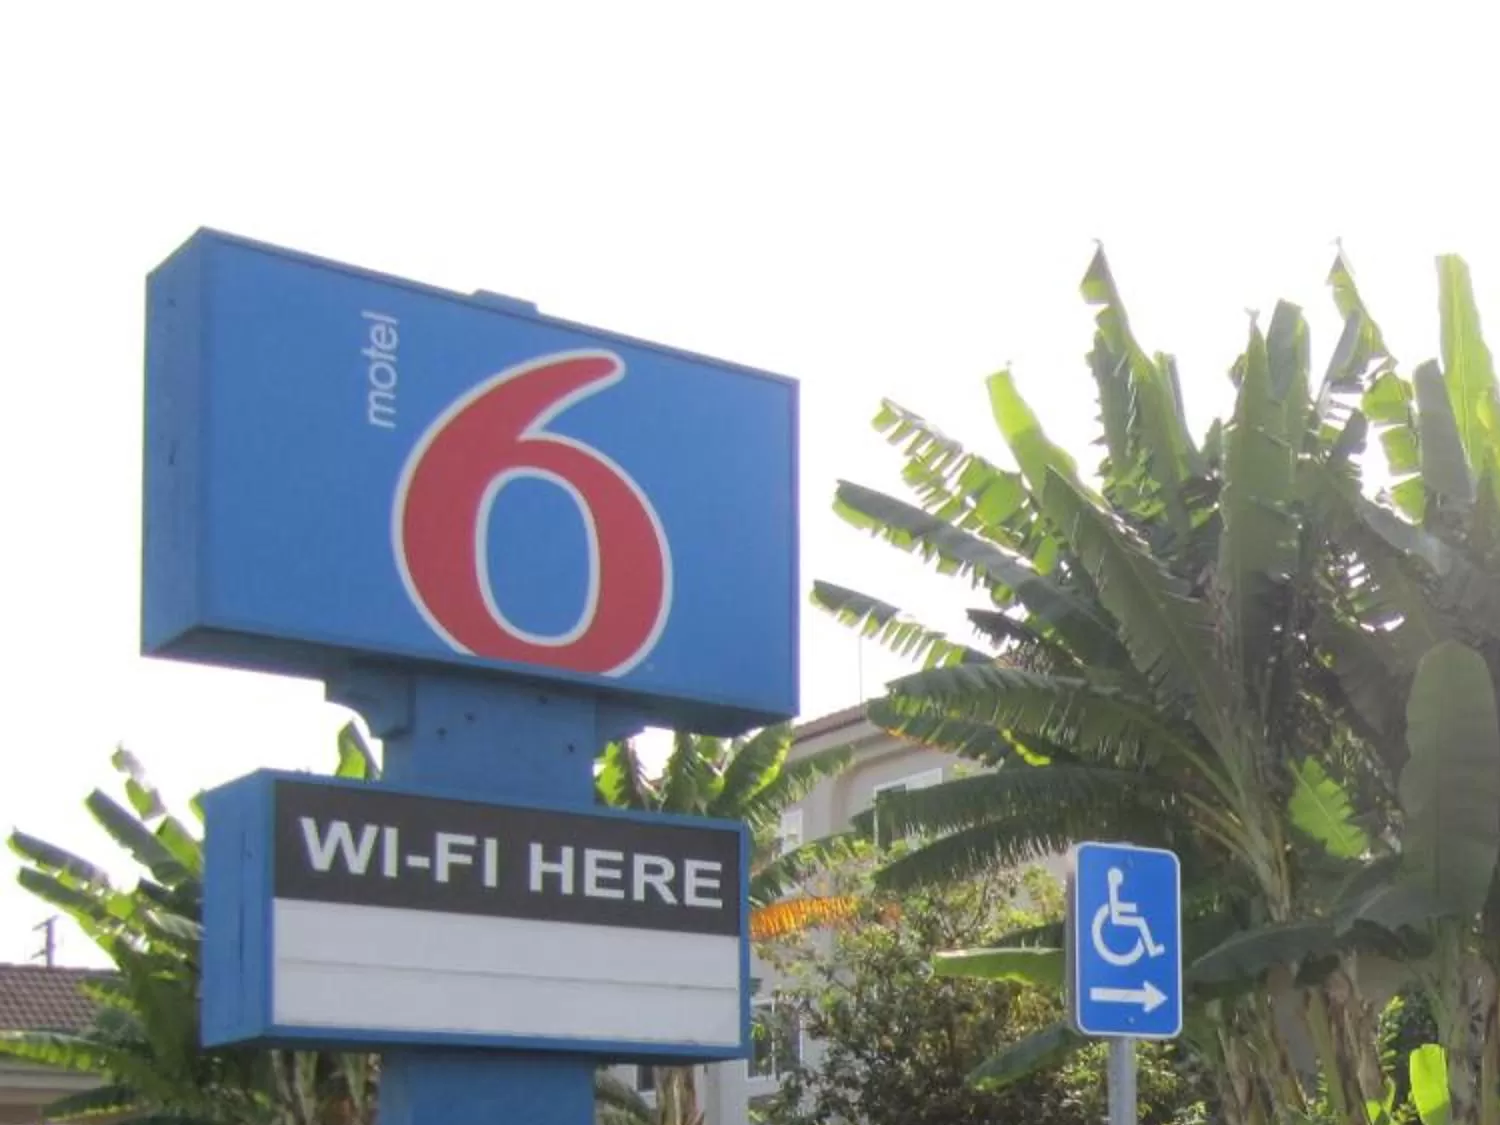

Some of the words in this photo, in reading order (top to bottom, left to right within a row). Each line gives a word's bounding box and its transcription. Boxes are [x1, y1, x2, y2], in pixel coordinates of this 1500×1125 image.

[361, 310, 398, 428] motel
[391, 348, 673, 678] 6
[300, 816, 497, 888] WI-FI
[529, 842, 723, 909] HERE
